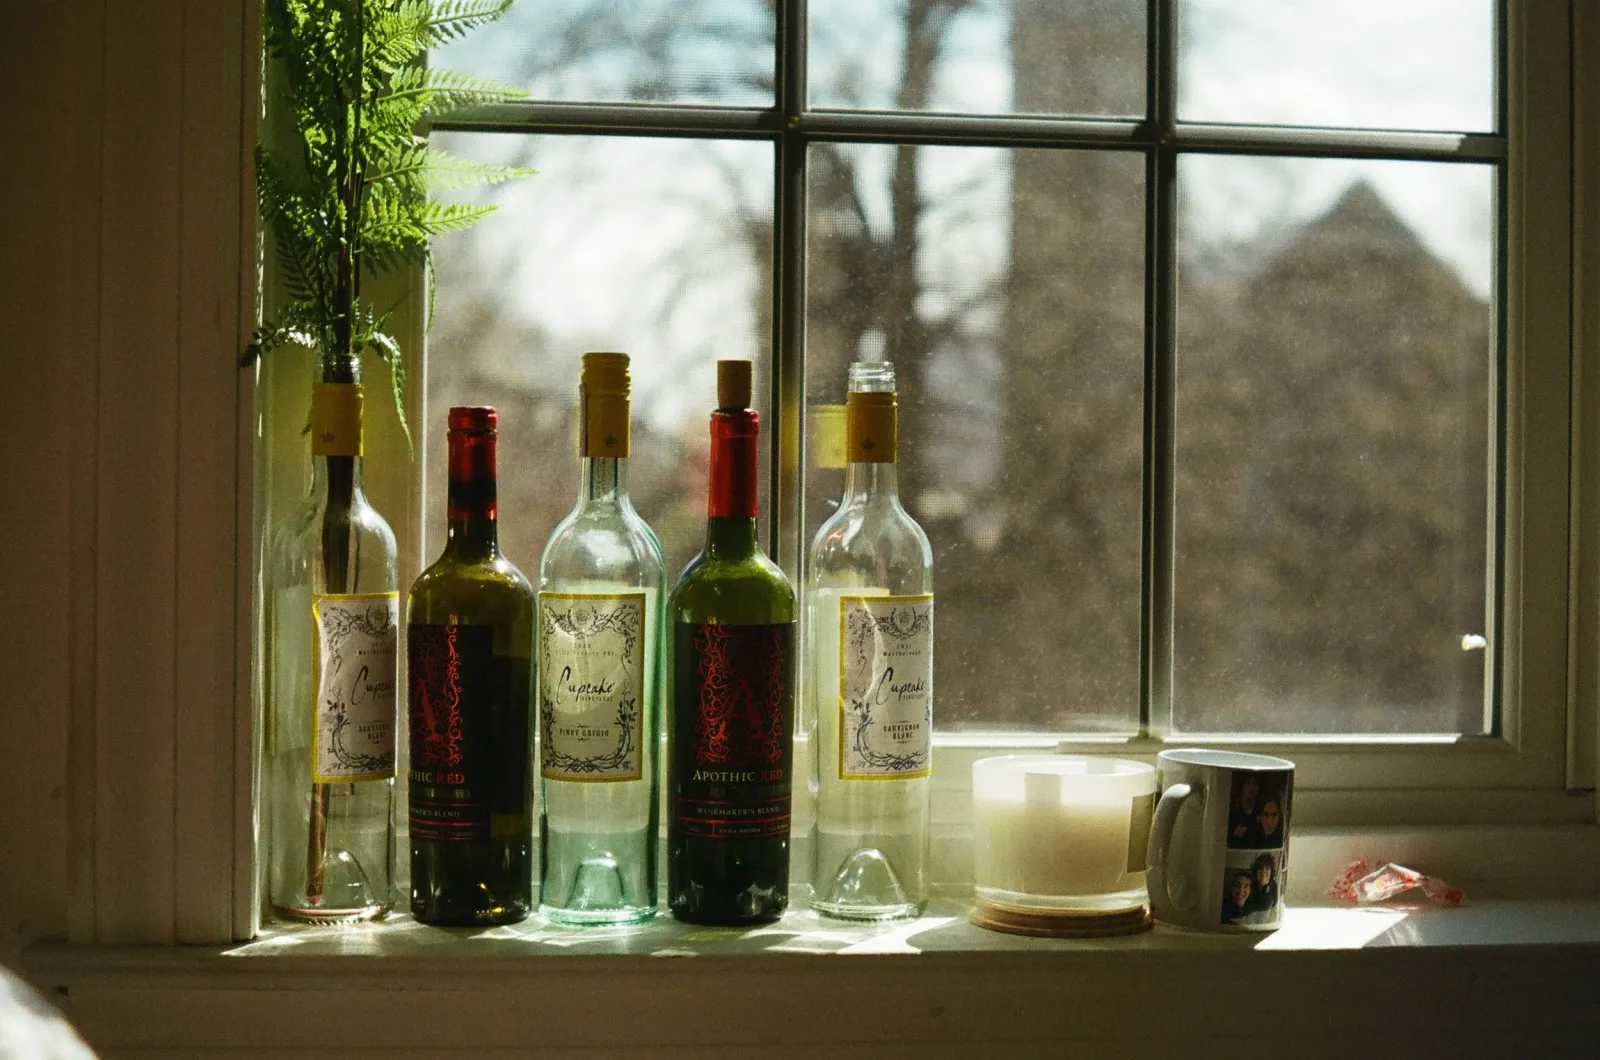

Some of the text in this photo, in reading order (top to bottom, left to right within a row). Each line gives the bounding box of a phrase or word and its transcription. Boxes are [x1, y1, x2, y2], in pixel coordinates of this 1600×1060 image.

[556, 666, 615, 704] Cupcake
[876, 666, 925, 705] Cupcake
[436, 769, 465, 784] RED
[693, 767, 783, 782] APOTHIC RED
